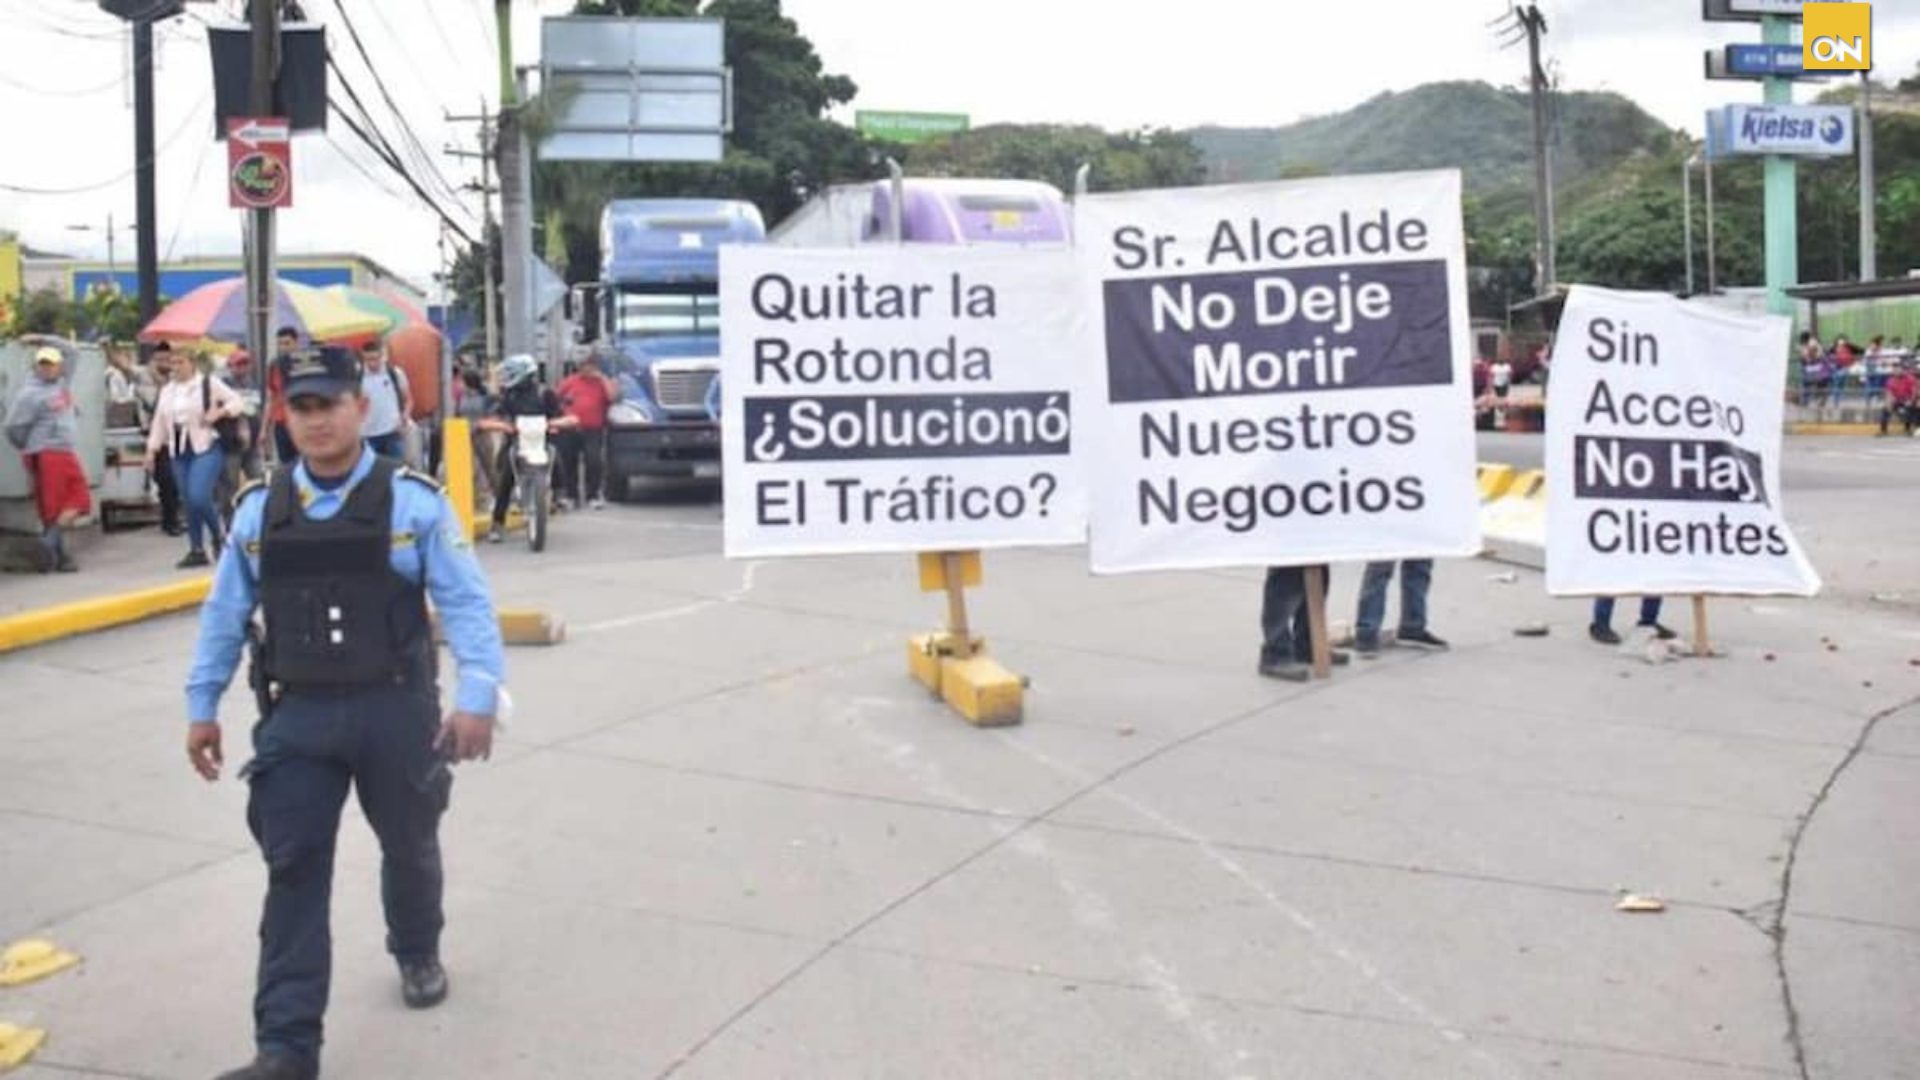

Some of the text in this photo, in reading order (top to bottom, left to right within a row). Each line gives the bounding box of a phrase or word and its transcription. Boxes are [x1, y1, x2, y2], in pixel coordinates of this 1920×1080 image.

[1112, 209, 1428, 270] Sr. Alcalde
[750, 273, 997, 323] Quitar la
[1151, 272, 1391, 333] No Deje
[753, 336, 992, 384] Rotonda
[1193, 337, 1358, 393] Morir
[1586, 318, 1659, 366] Sin
[752, 396, 1069, 462] ¿Solucionó
[1139, 404, 1416, 459] Nuestros
[1585, 439, 1654, 487] No
[756, 472, 1057, 526] El Tráfico?
[1138, 467, 1425, 533] Negocios
[1587, 509, 1789, 556] Clientes
